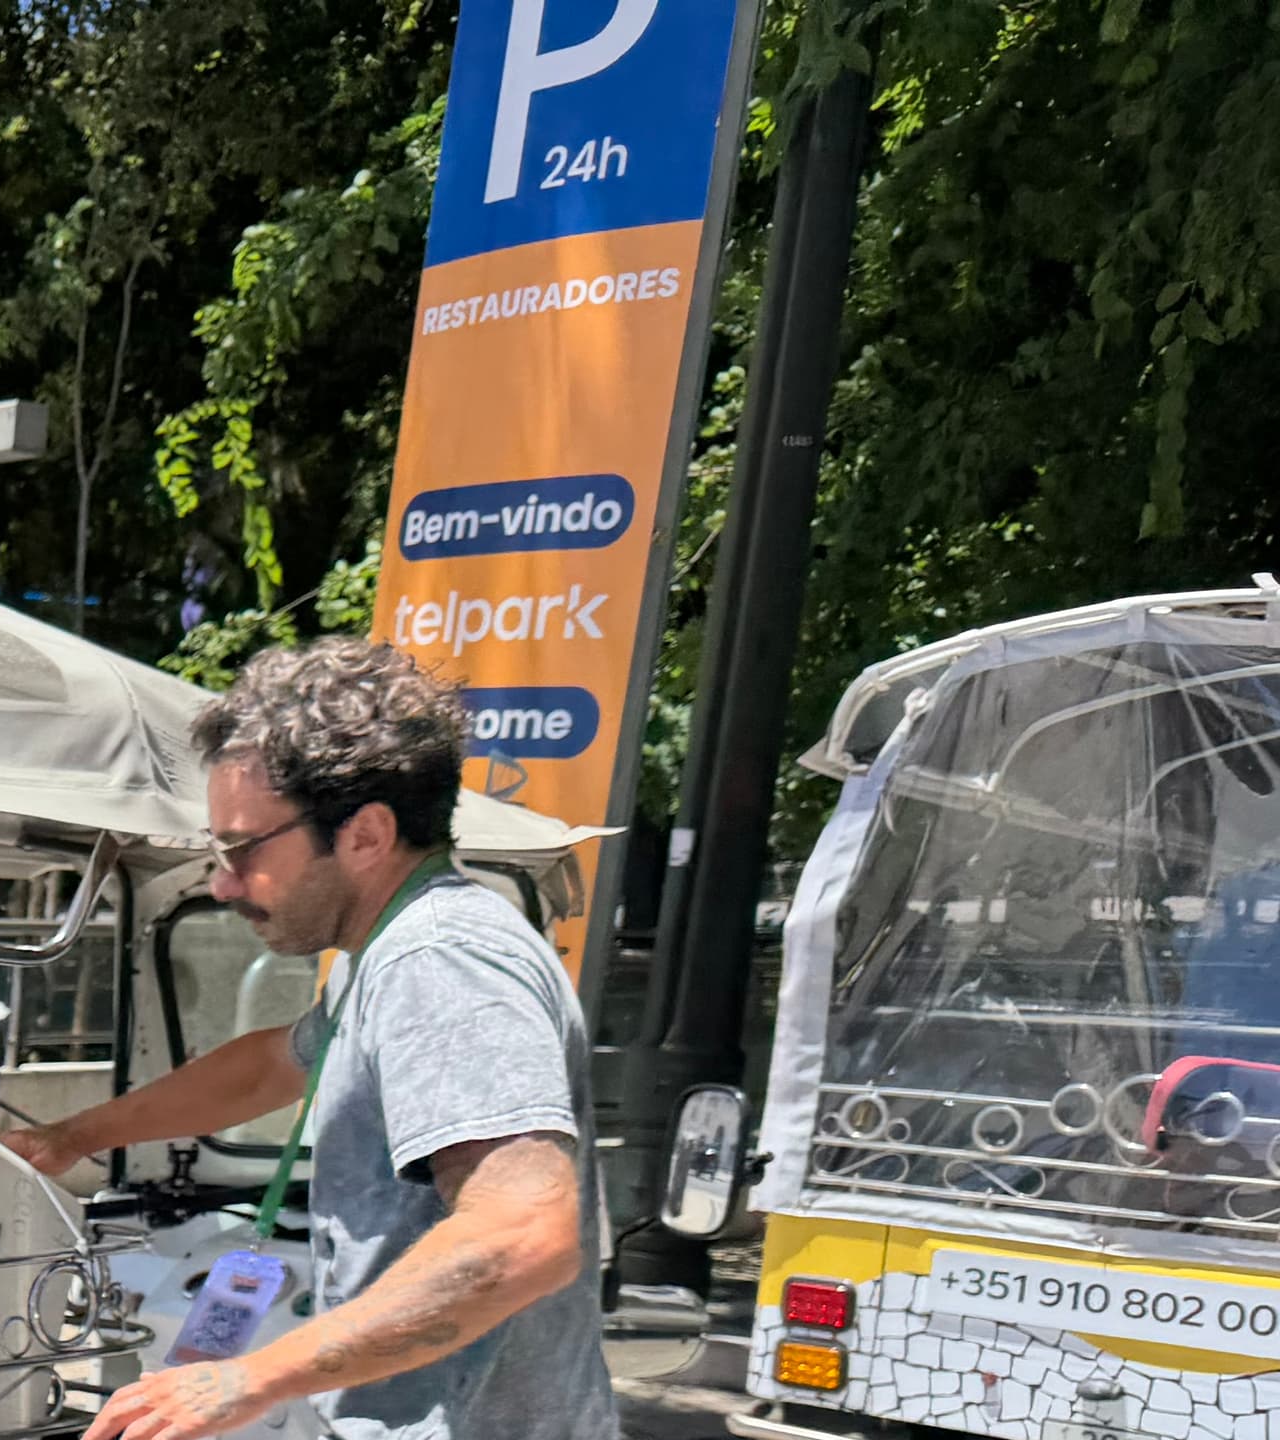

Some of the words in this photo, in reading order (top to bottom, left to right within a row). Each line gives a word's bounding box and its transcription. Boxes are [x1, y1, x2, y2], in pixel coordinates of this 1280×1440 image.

[483, 0, 659, 203] P
[539, 135, 629, 190] 24h
[421, 267, 681, 336] RESTAURADORES
[403, 492, 623, 546] Bem-vindo
[395, 583, 609, 657] telpark
[940, 1267, 1028, 1304] +351
[1039, 1277, 1111, 1314] 910
[1121, 1288, 1205, 1328] 802
